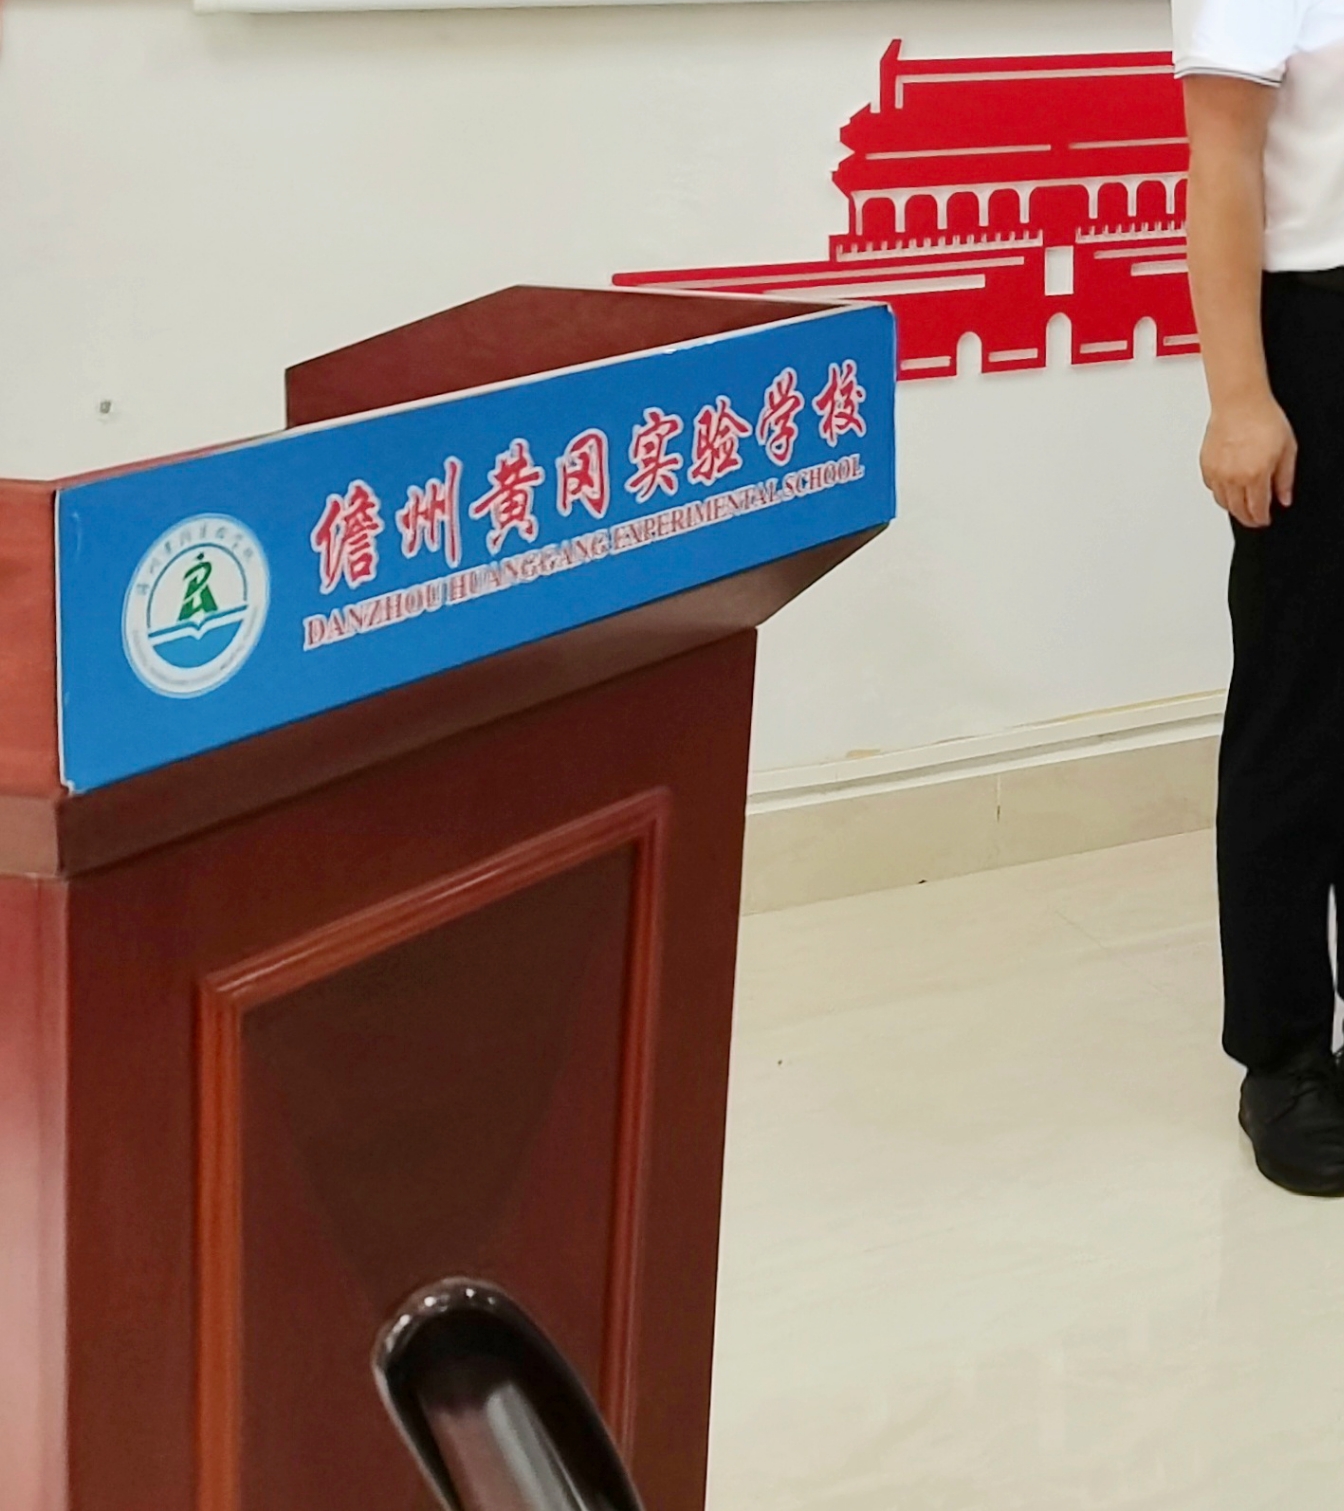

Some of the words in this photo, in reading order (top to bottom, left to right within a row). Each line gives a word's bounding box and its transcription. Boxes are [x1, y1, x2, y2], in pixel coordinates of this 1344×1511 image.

[304, 581, 442, 651] DANZHOU
[441, 531, 609, 605] HUANGGANG
[611, 478, 783, 555] EXPERIMENTAL
[783, 454, 866, 501] SCHOOL
[310, 360, 867, 594] 儋州黄冈实验学校
